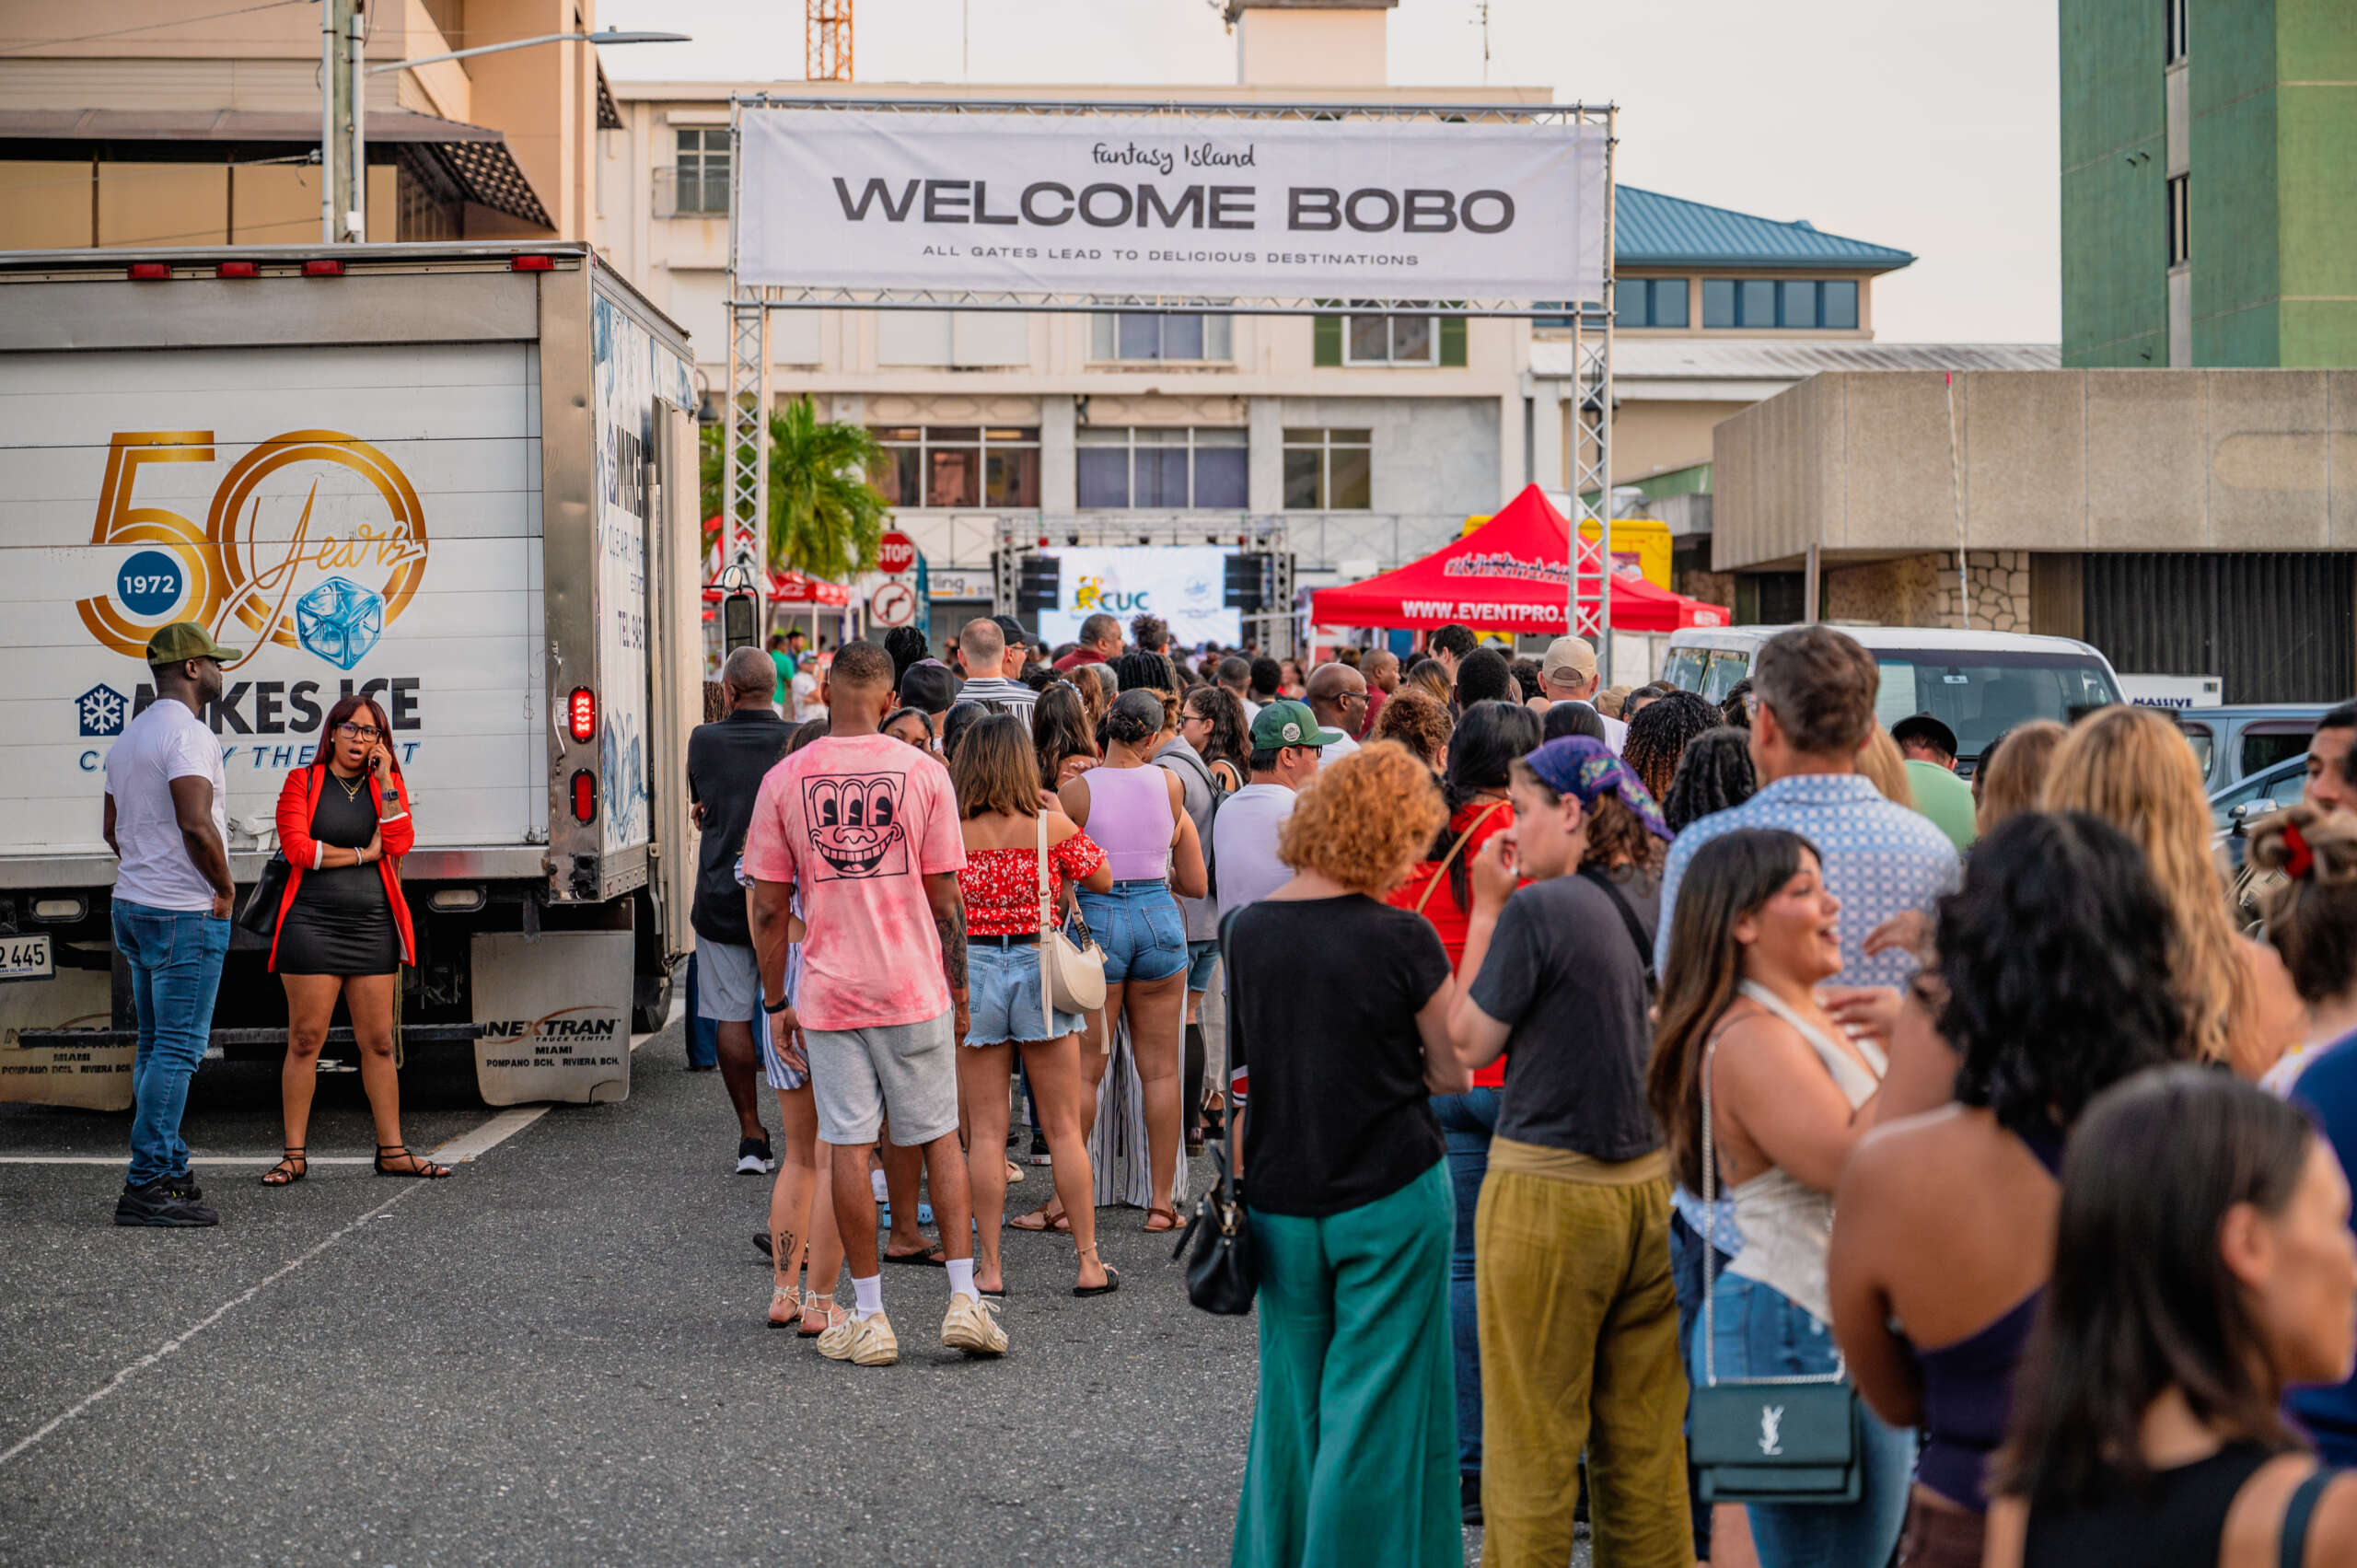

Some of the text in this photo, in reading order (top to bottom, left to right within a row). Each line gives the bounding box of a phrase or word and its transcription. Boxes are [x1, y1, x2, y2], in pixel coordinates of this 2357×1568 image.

[1184, 143, 1256, 168] Island
[831, 177, 1515, 234] WELCOME BOBO
[923, 245, 1419, 265] ALL GATES LEAD TO DELICIOUS DESTINATIONS
[75, 429, 428, 659] 50
[876, 543, 911, 563] STOP
[123, 575, 175, 594] 1972
[214, 478, 424, 671] Years
[2132, 698, 2193, 707] MASSIVE
[252, 744, 318, 769] THE
[11, 944, 44, 967] 445
[487, 1018, 617, 1038] NEXTRAN
[53, 1053, 90, 1062] MIAMI
[535, 1046, 573, 1055] MIAMI
[80, 1064, 112, 1074] RIVIERA
[486, 1059, 530, 1068] POMPANO
[563, 1058, 597, 1067] RIVIERA
